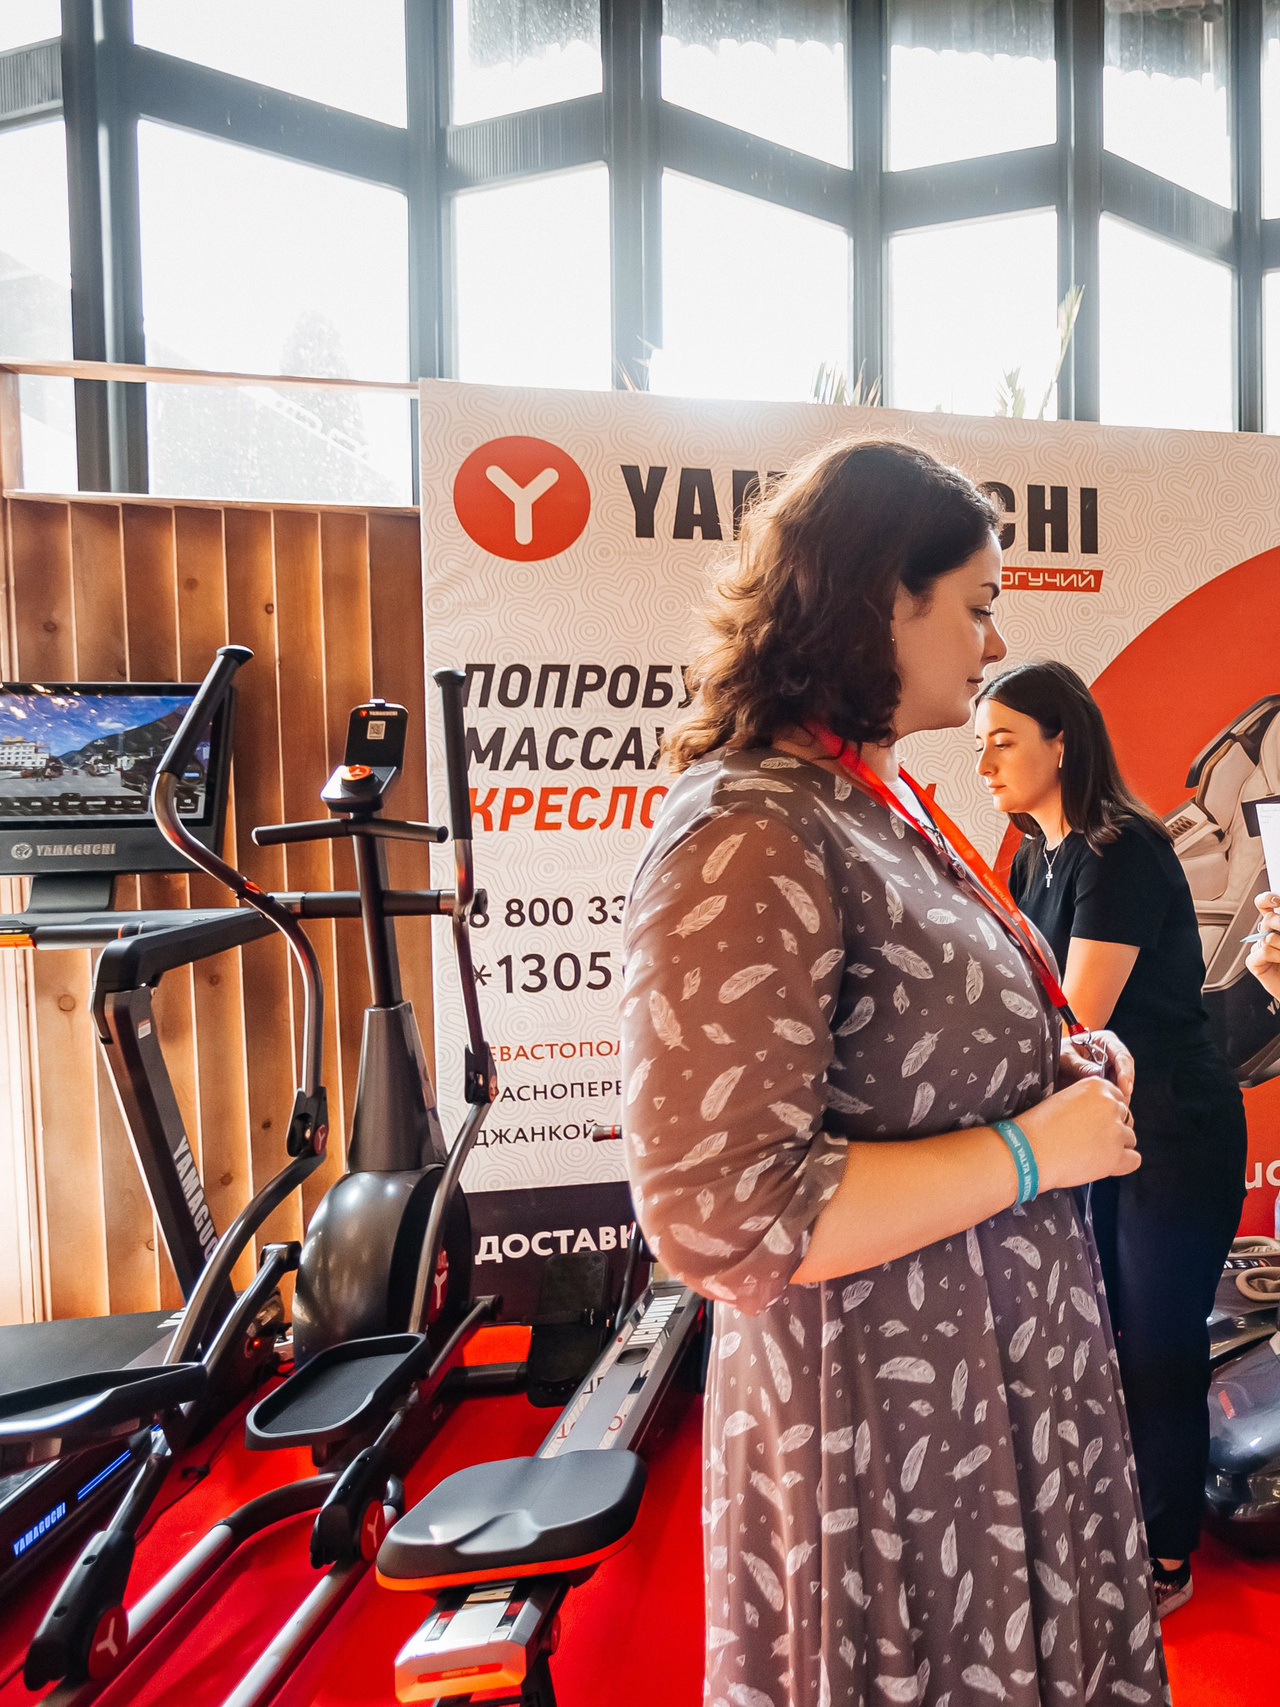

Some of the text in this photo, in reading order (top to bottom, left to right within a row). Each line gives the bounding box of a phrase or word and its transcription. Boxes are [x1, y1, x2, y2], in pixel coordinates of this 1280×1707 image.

[36, 843, 116, 857] YAMAGUCHI
[505, 896, 574, 928] 800
[1017, 1145, 1030, 1175] YALTA
[13, 1502, 66, 1557] YAMAGUCHI
